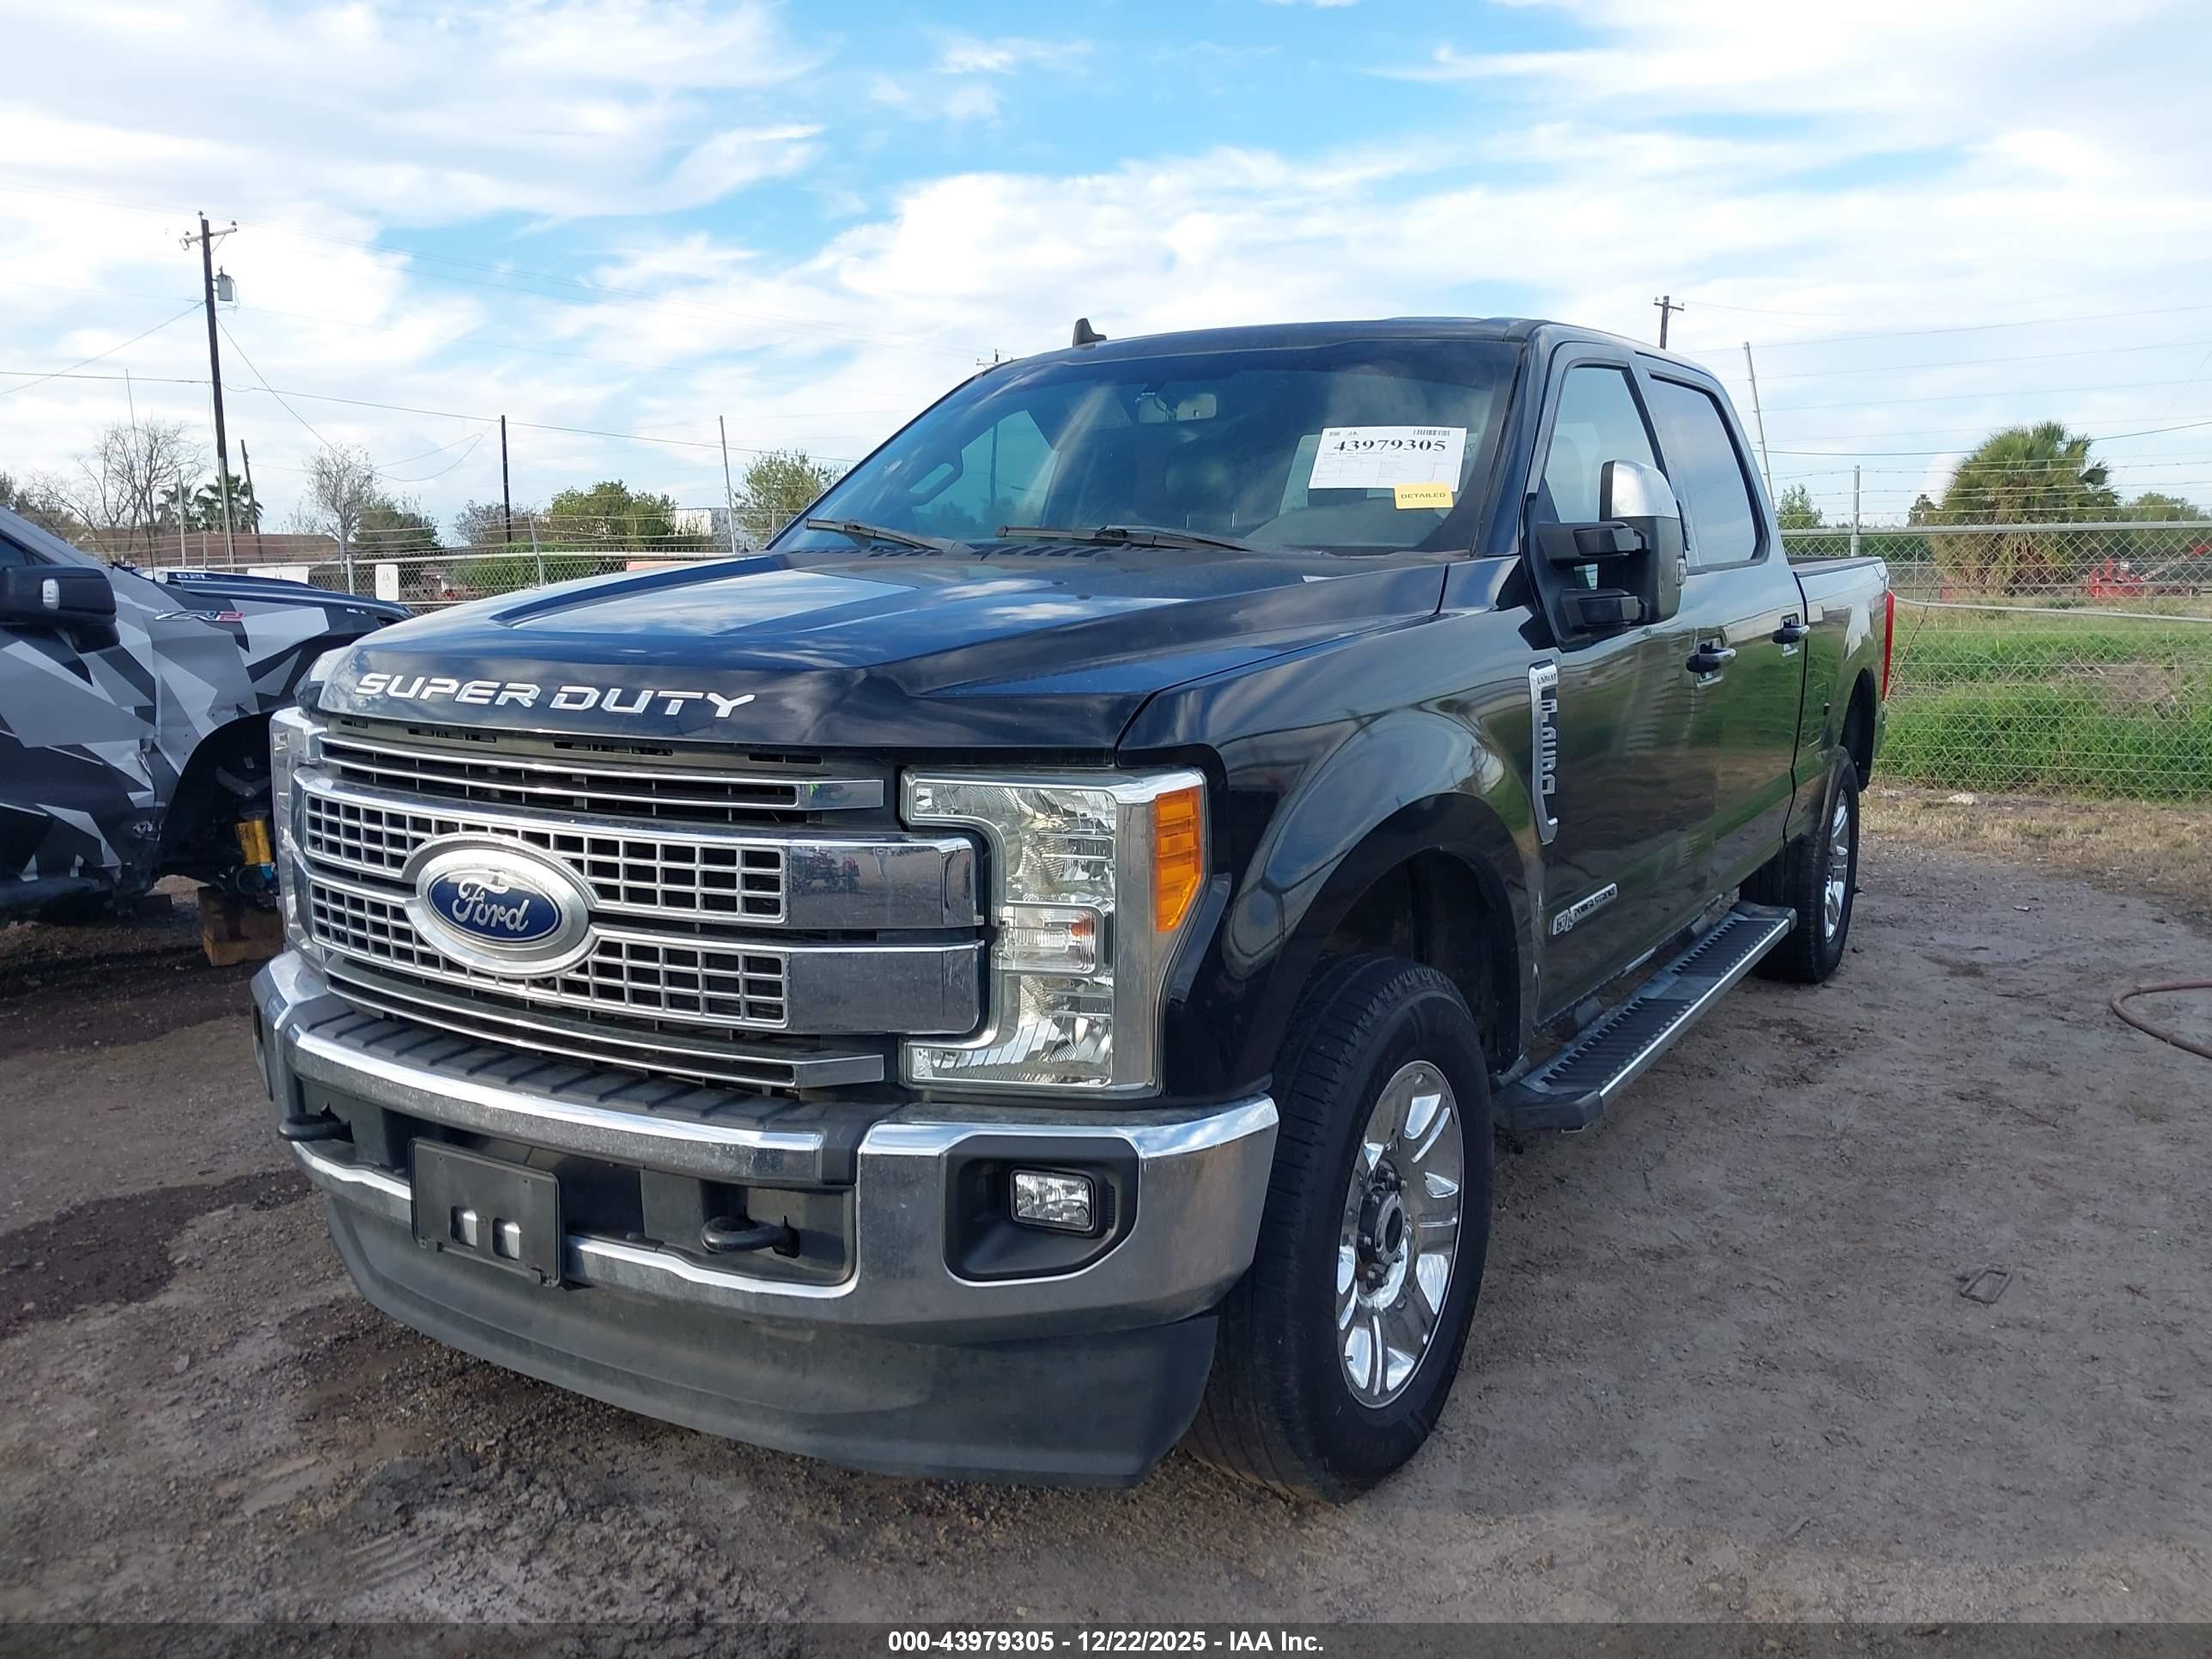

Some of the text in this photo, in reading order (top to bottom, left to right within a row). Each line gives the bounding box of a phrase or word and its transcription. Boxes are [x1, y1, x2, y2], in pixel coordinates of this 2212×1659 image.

[1333, 439, 1447, 452] 43979305
[1401, 491, 1447, 500] DETAILED
[354, 672, 756, 718] SUPER DUTY
[452, 878, 529, 932] Ford
